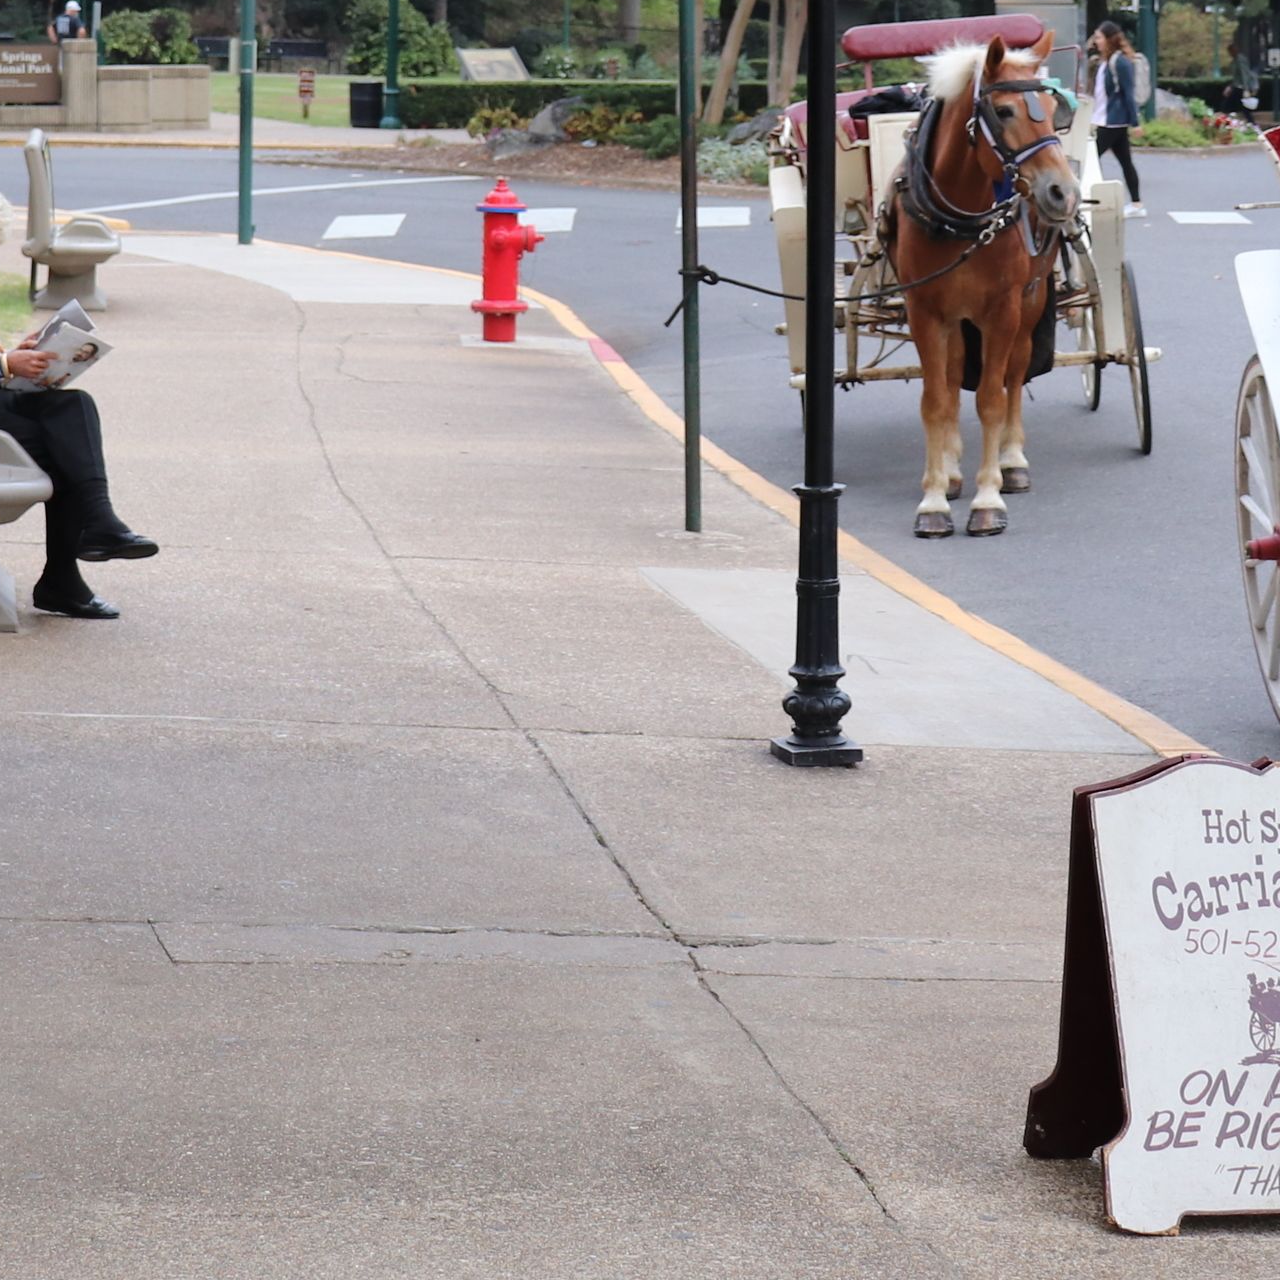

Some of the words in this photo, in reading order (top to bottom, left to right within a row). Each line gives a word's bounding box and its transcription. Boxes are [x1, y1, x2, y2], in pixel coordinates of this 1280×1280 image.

[1, 51, 43, 64] Springs
[27, 63, 53, 74] Park
[1202, 808, 1254, 844] Hot
[1179, 1069, 1250, 1107] ON
[1142, 1110, 1206, 1152] BE
